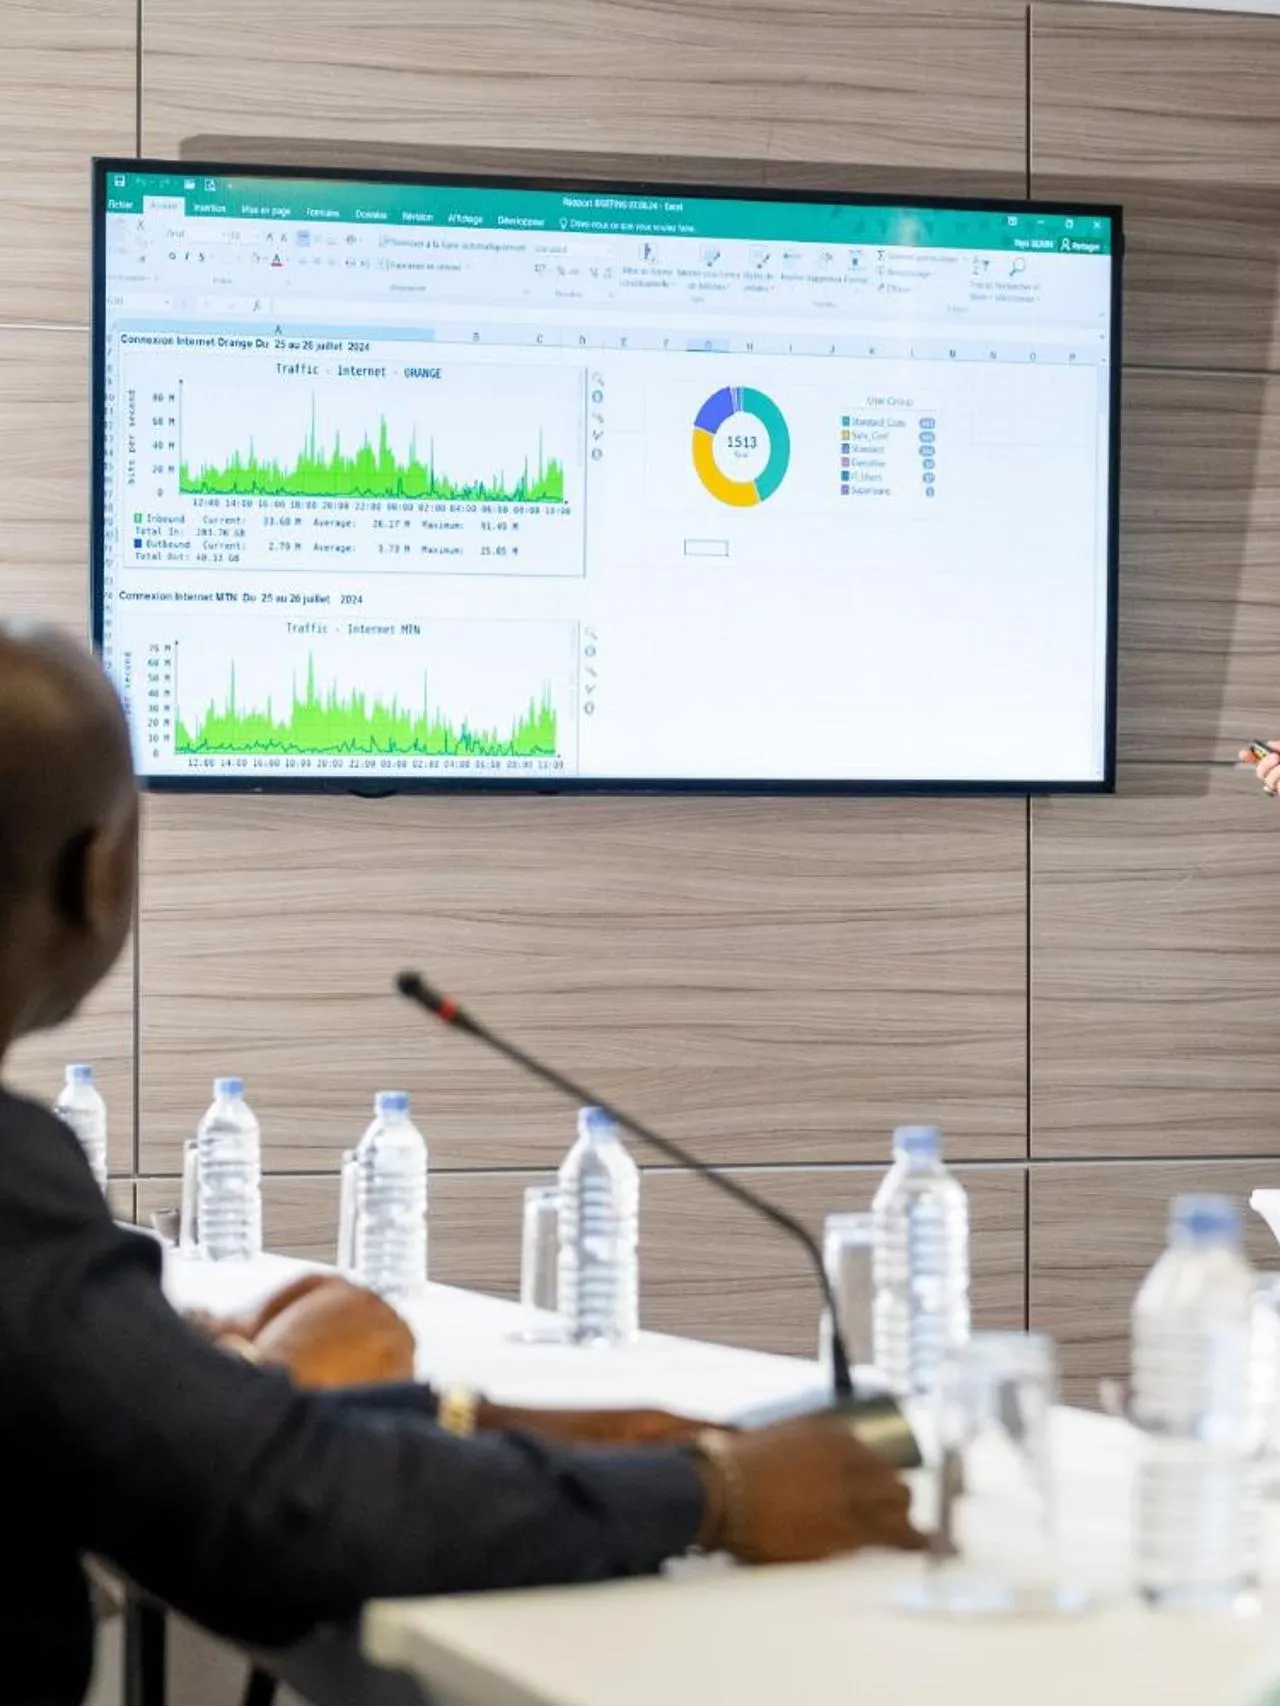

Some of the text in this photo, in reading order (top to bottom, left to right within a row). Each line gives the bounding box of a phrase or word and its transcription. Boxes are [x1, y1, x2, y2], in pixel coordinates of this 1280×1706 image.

[120, 333, 173, 346] Connexion
[176, 335, 215, 347] Internet
[218, 337, 253, 350] Orange
[256, 338, 269, 348] Du
[274, 339, 285, 349] 25
[288, 342, 300, 350] au
[316, 341, 342, 353] juillet
[348, 341, 370, 352] 2024
[276, 362, 442, 379] Traffic Internet ORANGE
[727, 435, 757, 450] 1513
[147, 513, 185, 524] Inbound
[313, 518, 356, 529] Average:
[135, 526, 161, 536] Total
[146, 539, 191, 549] Outbound
[313, 543, 356, 554] Average:
[135, 552, 161, 561] Total
[119, 590, 173, 601] Connexion
[175, 591, 214, 602] Internet
[215, 593, 239, 602] MTN
[242, 593, 257, 603] Du
[261, 593, 273, 603] 25
[289, 594, 301, 604] 26
[303, 594, 330, 606] juillet
[340, 594, 363, 605] 2024
[287, 622, 421, 635] Traffic Internet MTN
